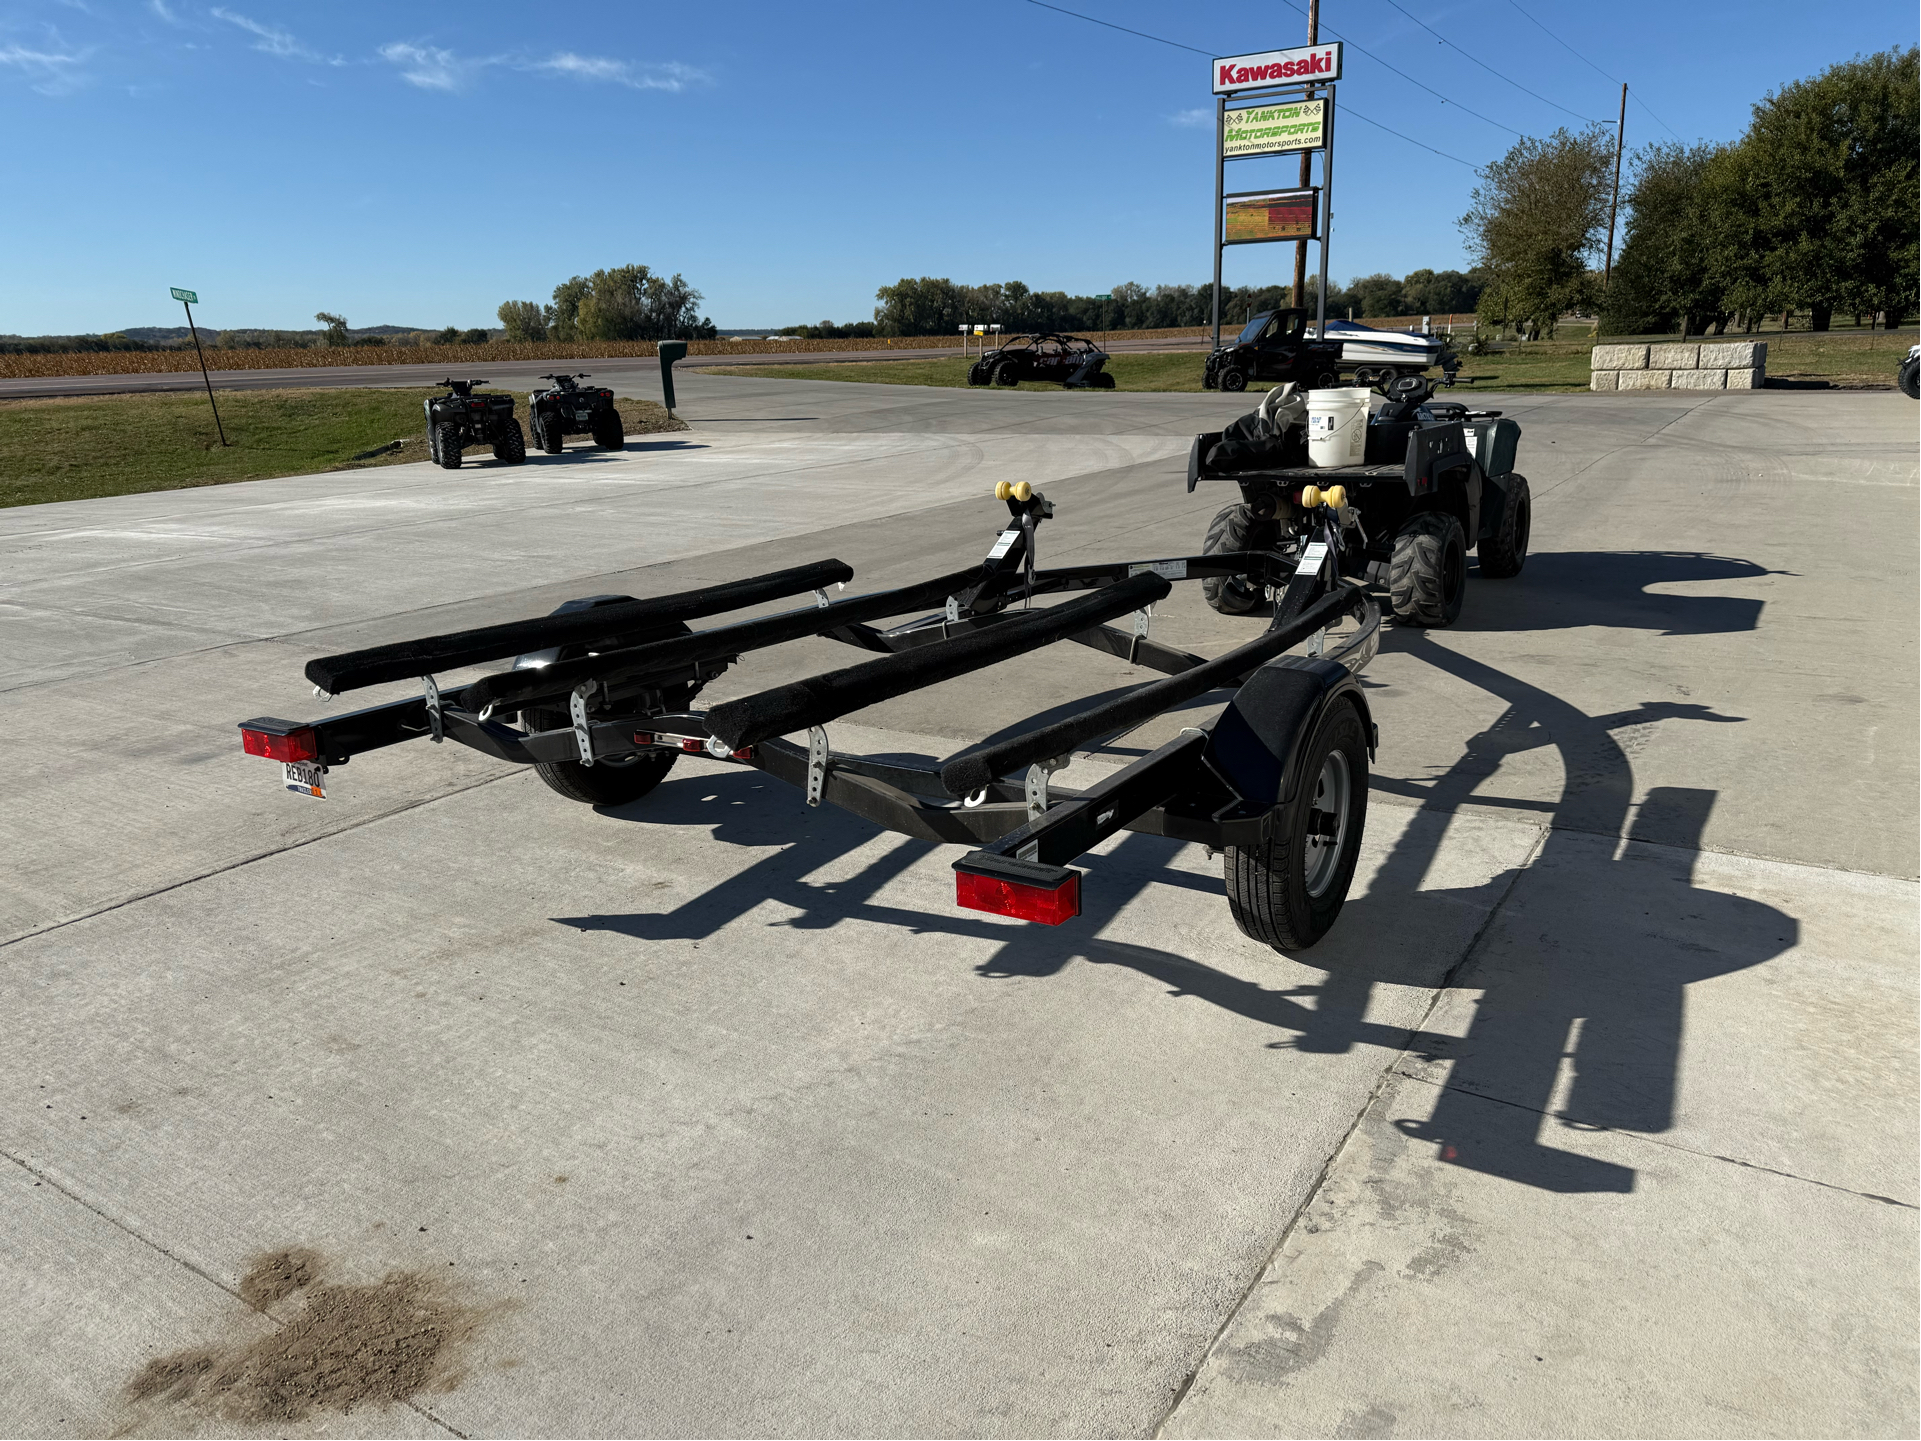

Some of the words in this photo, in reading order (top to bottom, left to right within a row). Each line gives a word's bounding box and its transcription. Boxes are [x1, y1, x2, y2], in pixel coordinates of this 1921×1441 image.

[1220, 51, 1331, 85] Kawasaki
[1224, 136, 1321, 155] yanktonmotorsports.com
[286, 763, 320, 788] REB180
